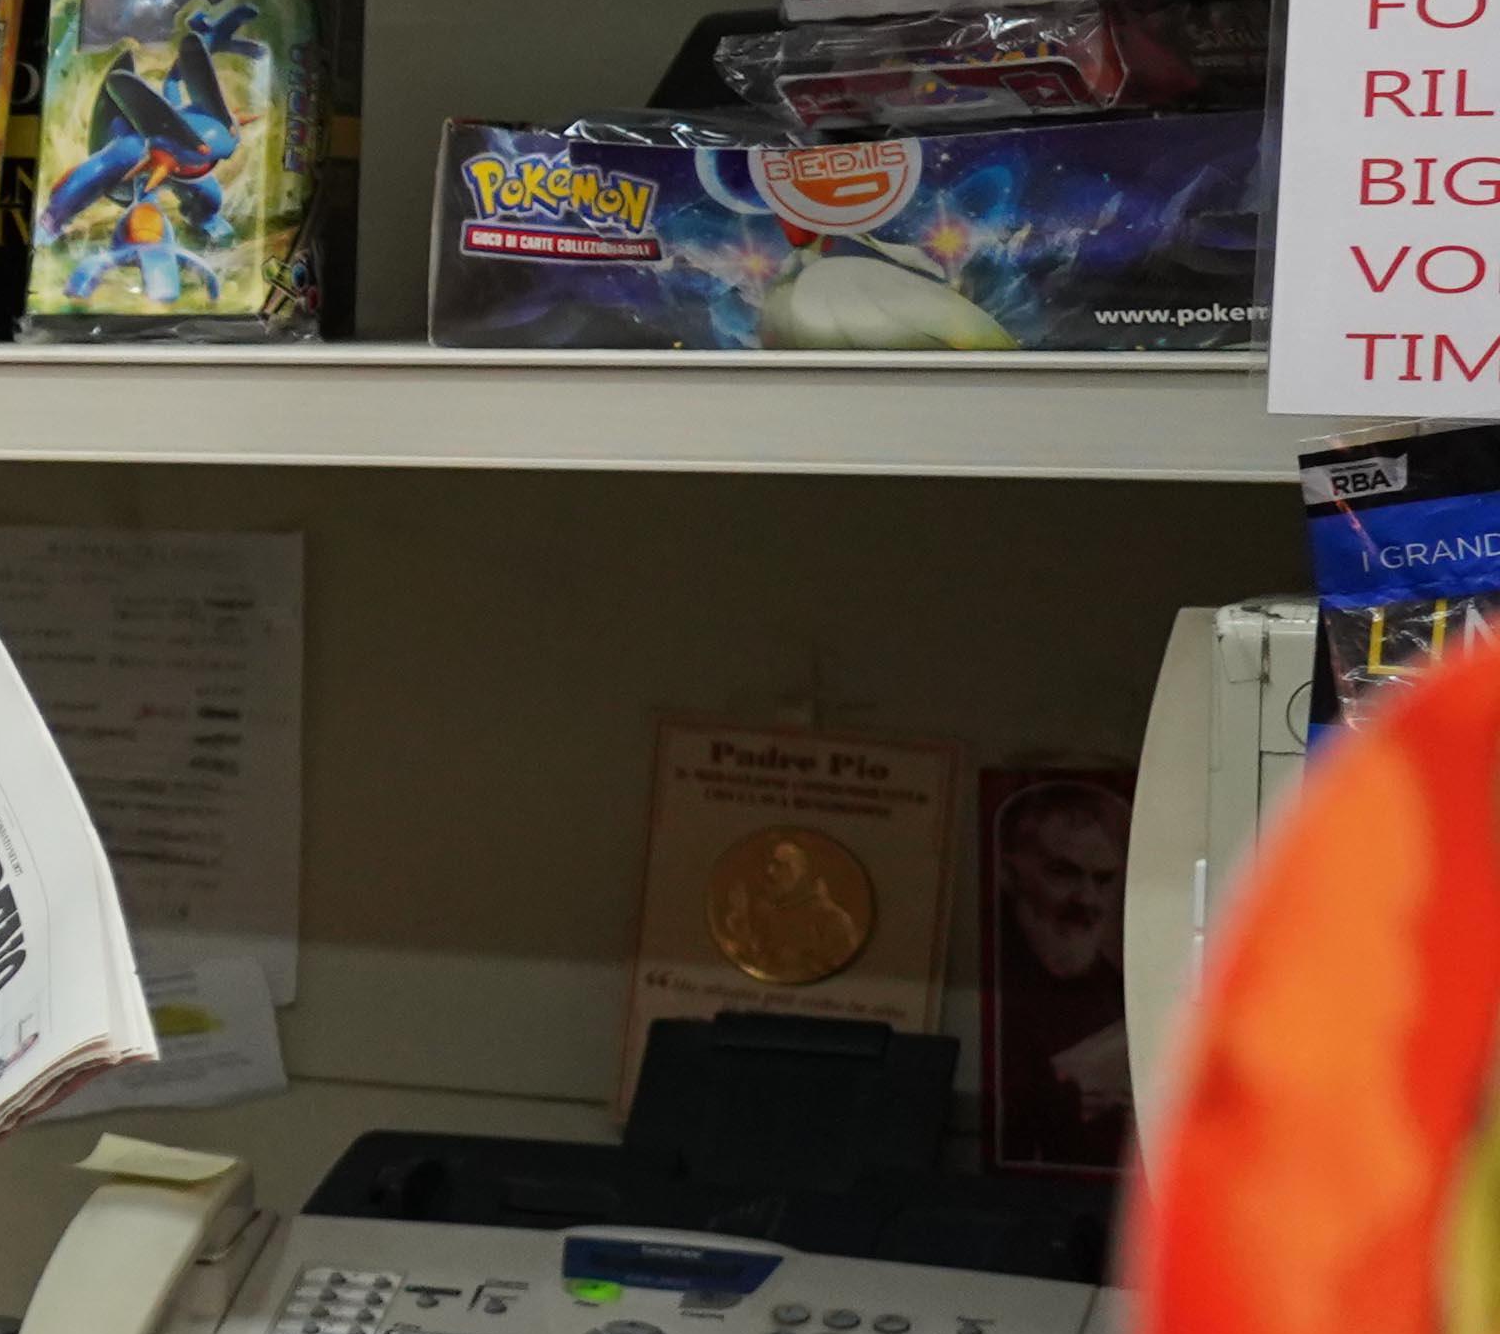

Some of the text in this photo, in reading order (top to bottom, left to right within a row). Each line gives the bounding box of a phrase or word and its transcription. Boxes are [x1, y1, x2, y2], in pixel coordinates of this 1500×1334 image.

[472, 230, 502, 246] GIOCO
[520, 234, 553, 250] CARTE
[1332, 467, 1393, 496] RBA
[710, 739, 891, 781] Padre Pio
